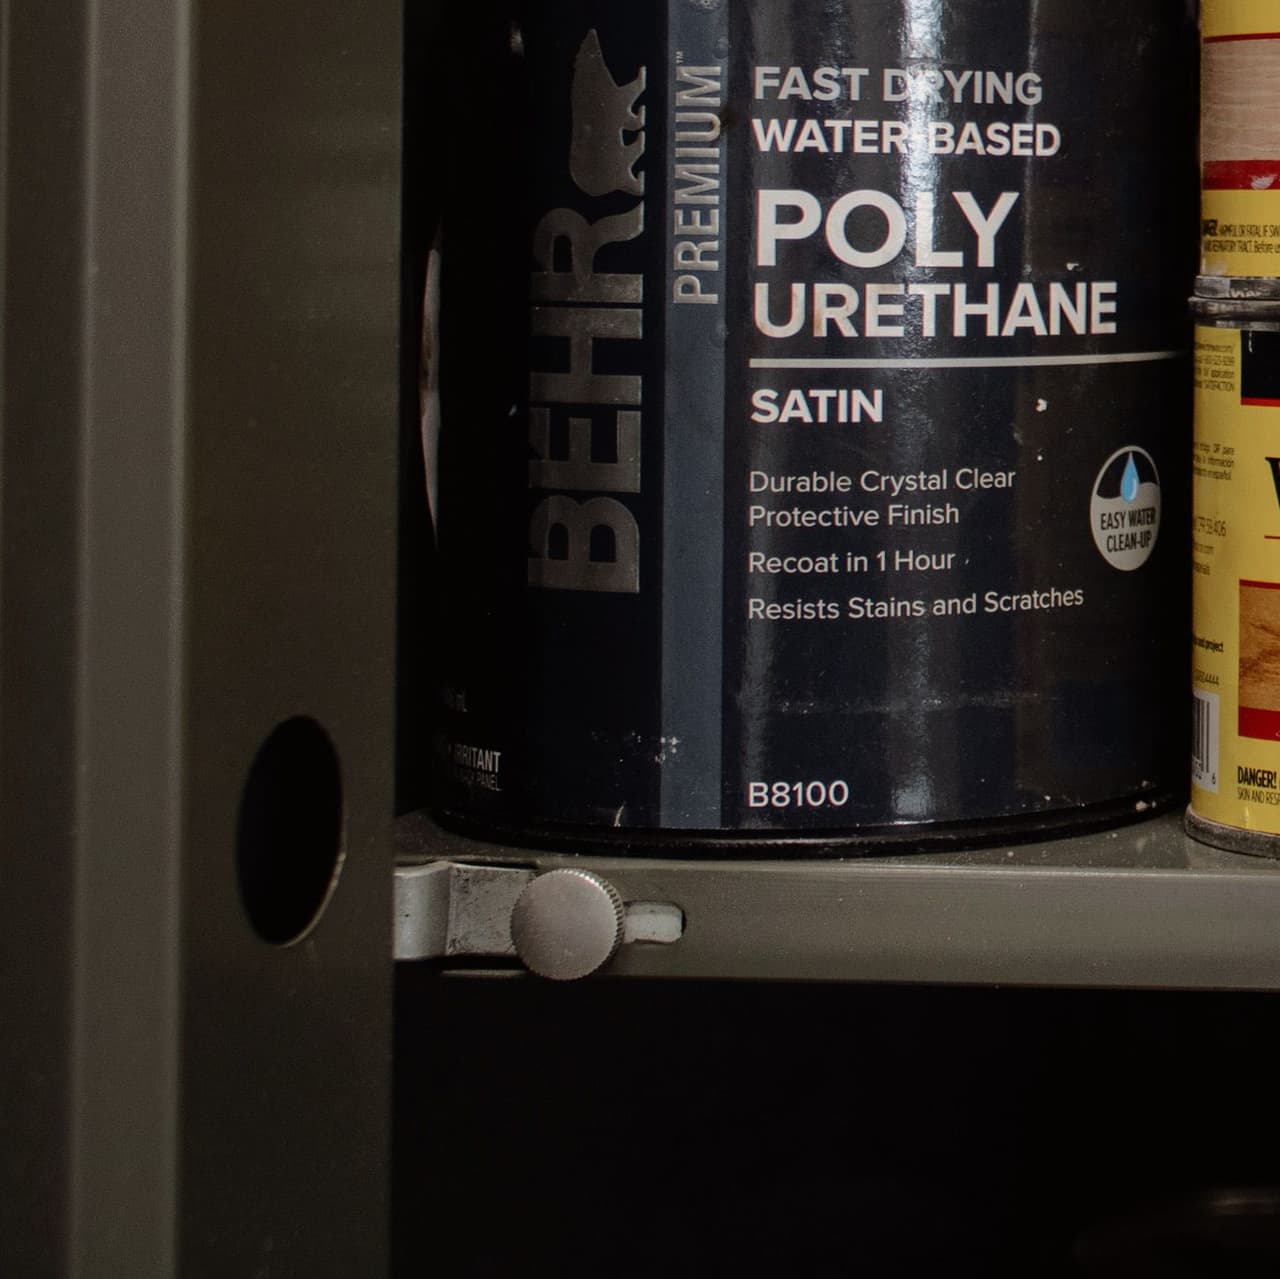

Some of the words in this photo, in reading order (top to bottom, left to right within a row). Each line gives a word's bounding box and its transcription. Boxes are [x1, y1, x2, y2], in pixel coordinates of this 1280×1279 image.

[754, 67, 869, 101] FAST
[883, 68, 1042, 105] DRYING
[673, 65, 722, 306] PREMIUM
[757, 190, 1020, 269] POLY
[753, 282, 1117, 338] URETHANE
[527, 206, 645, 594] BEHR
[750, 390, 883, 424] SATIN
[750, 471, 851, 492] Durable
[861, 469, 947, 496] Crystal
[955, 469, 1016, 490] Clear
[750, 506, 879, 527] Protective
[888, 503, 959, 524] Finish
[1101, 512, 1126, 530] EASY
[1128, 507, 1156, 527] WATER
[1107, 531, 1152, 552] CLEAN-UP
[749, 552, 839, 573] Recoat
[847, 553, 868, 573] in
[877, 552, 887, 572] 1
[895, 551, 955, 571] Hour
[749, 599, 840, 620] Resists
[849, 598, 924, 618] Stains
[932, 594, 976, 615] and
[984, 587, 1084, 612] Scratches
[749, 782, 848, 807] B8100
